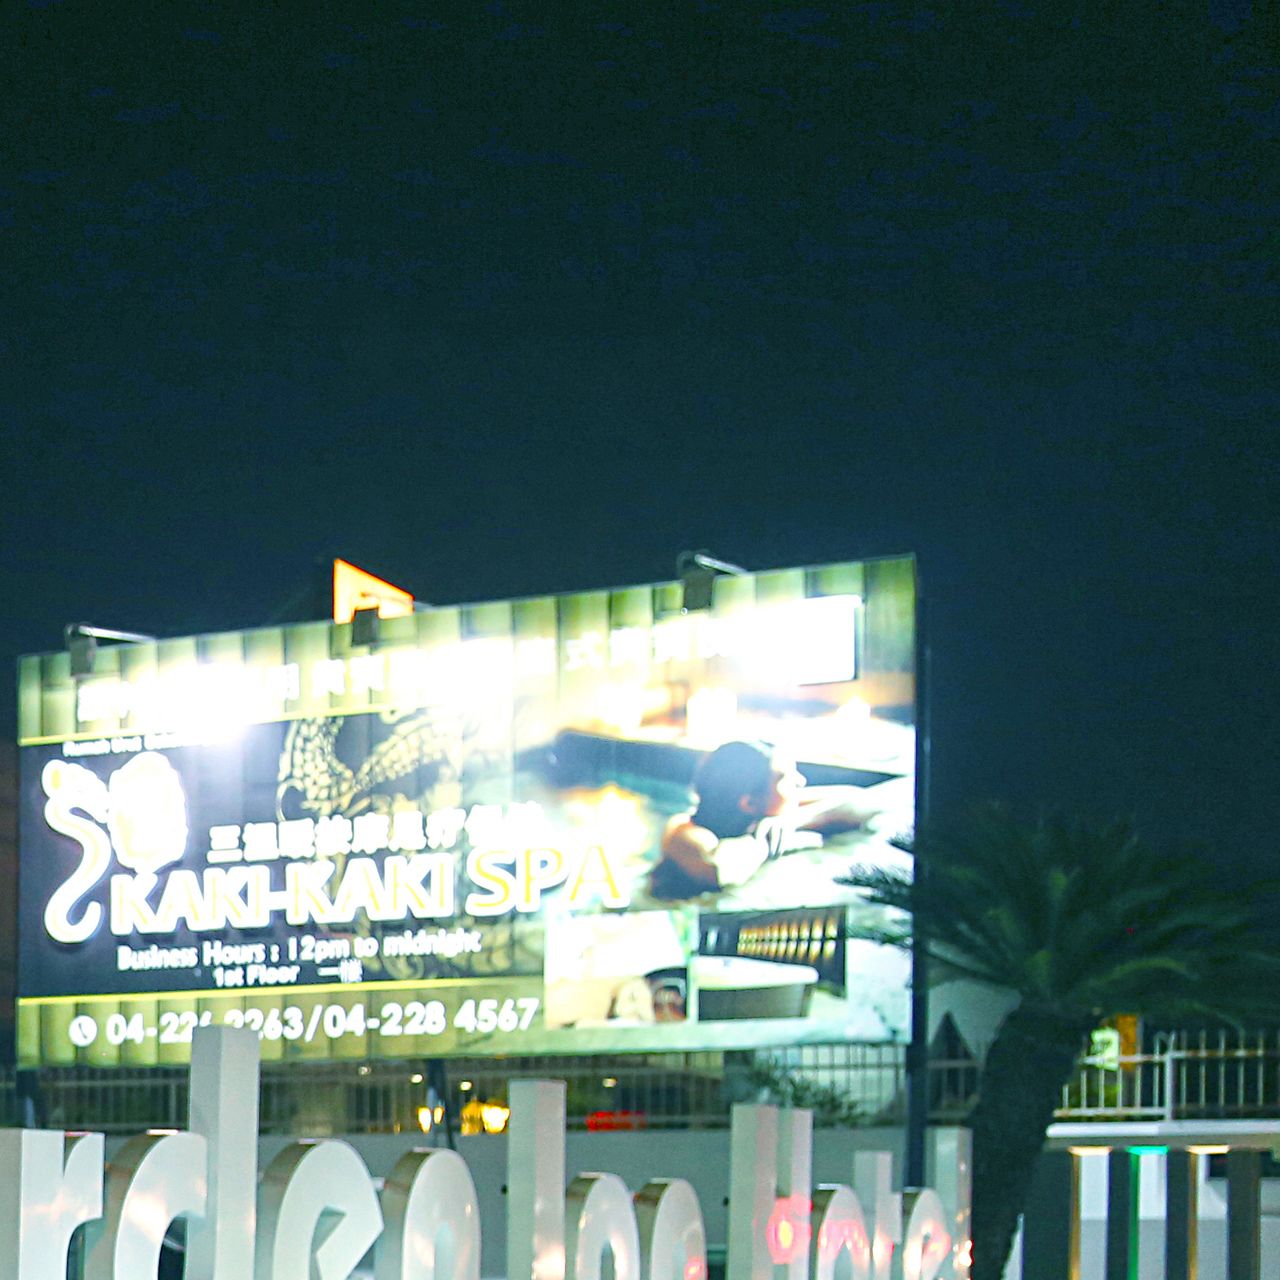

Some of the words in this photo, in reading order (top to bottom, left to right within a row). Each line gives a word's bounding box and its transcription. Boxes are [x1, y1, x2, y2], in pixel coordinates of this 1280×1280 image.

[110, 853, 455, 936] KAKI-KAKI
[464, 845, 632, 917] SPA
[116, 944, 198, 971] Business
[203, 940, 266, 966] Hours
[353, 935, 379, 958] to
[383, 928, 482, 958] midnight
[212, 966, 244, 987] 1st
[246, 963, 300, 985] Floor
[453, 997, 540, 1033] 4567
